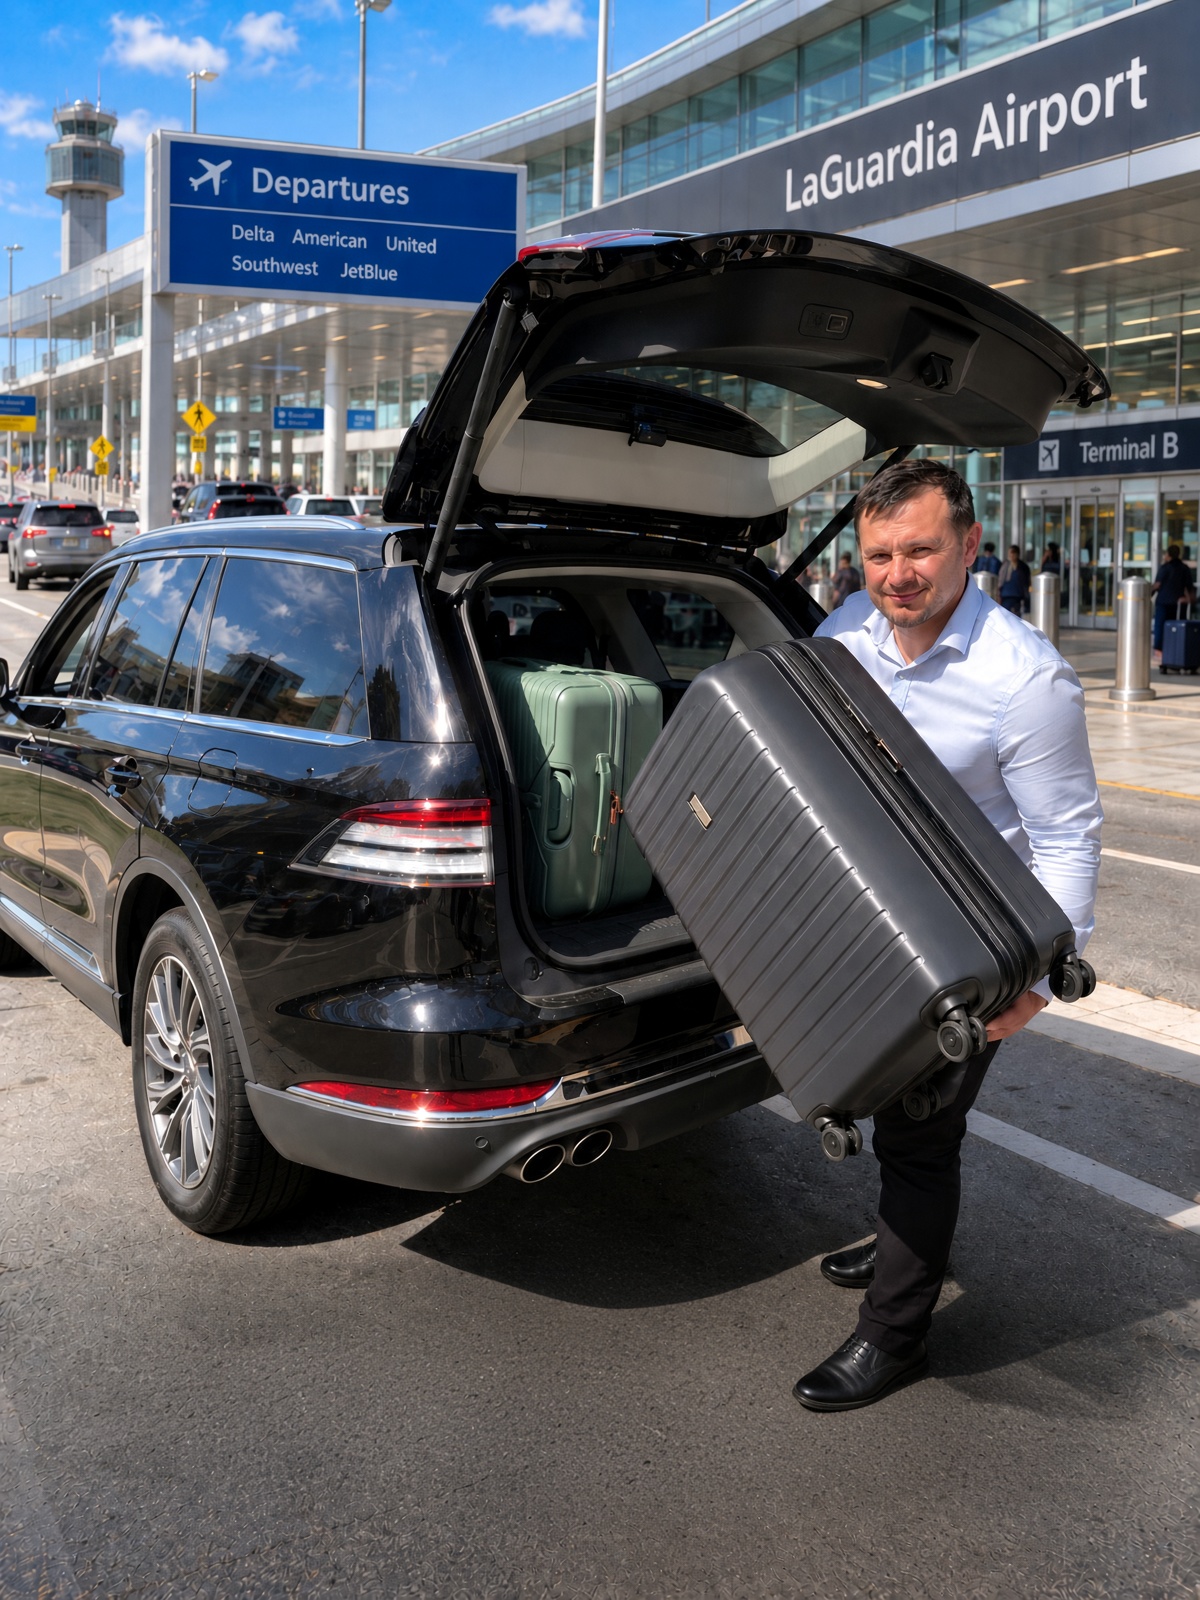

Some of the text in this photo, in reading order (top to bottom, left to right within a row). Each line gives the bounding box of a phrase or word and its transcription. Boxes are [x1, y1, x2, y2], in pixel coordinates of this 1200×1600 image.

[786, 56, 1148, 213] LaGuardia Airport
[252, 167, 410, 206] Departures
[232, 224, 437, 255] Delta American United
[232, 255, 398, 282] Southwest JetBlue
[1079, 431, 1180, 463] Terminal B
